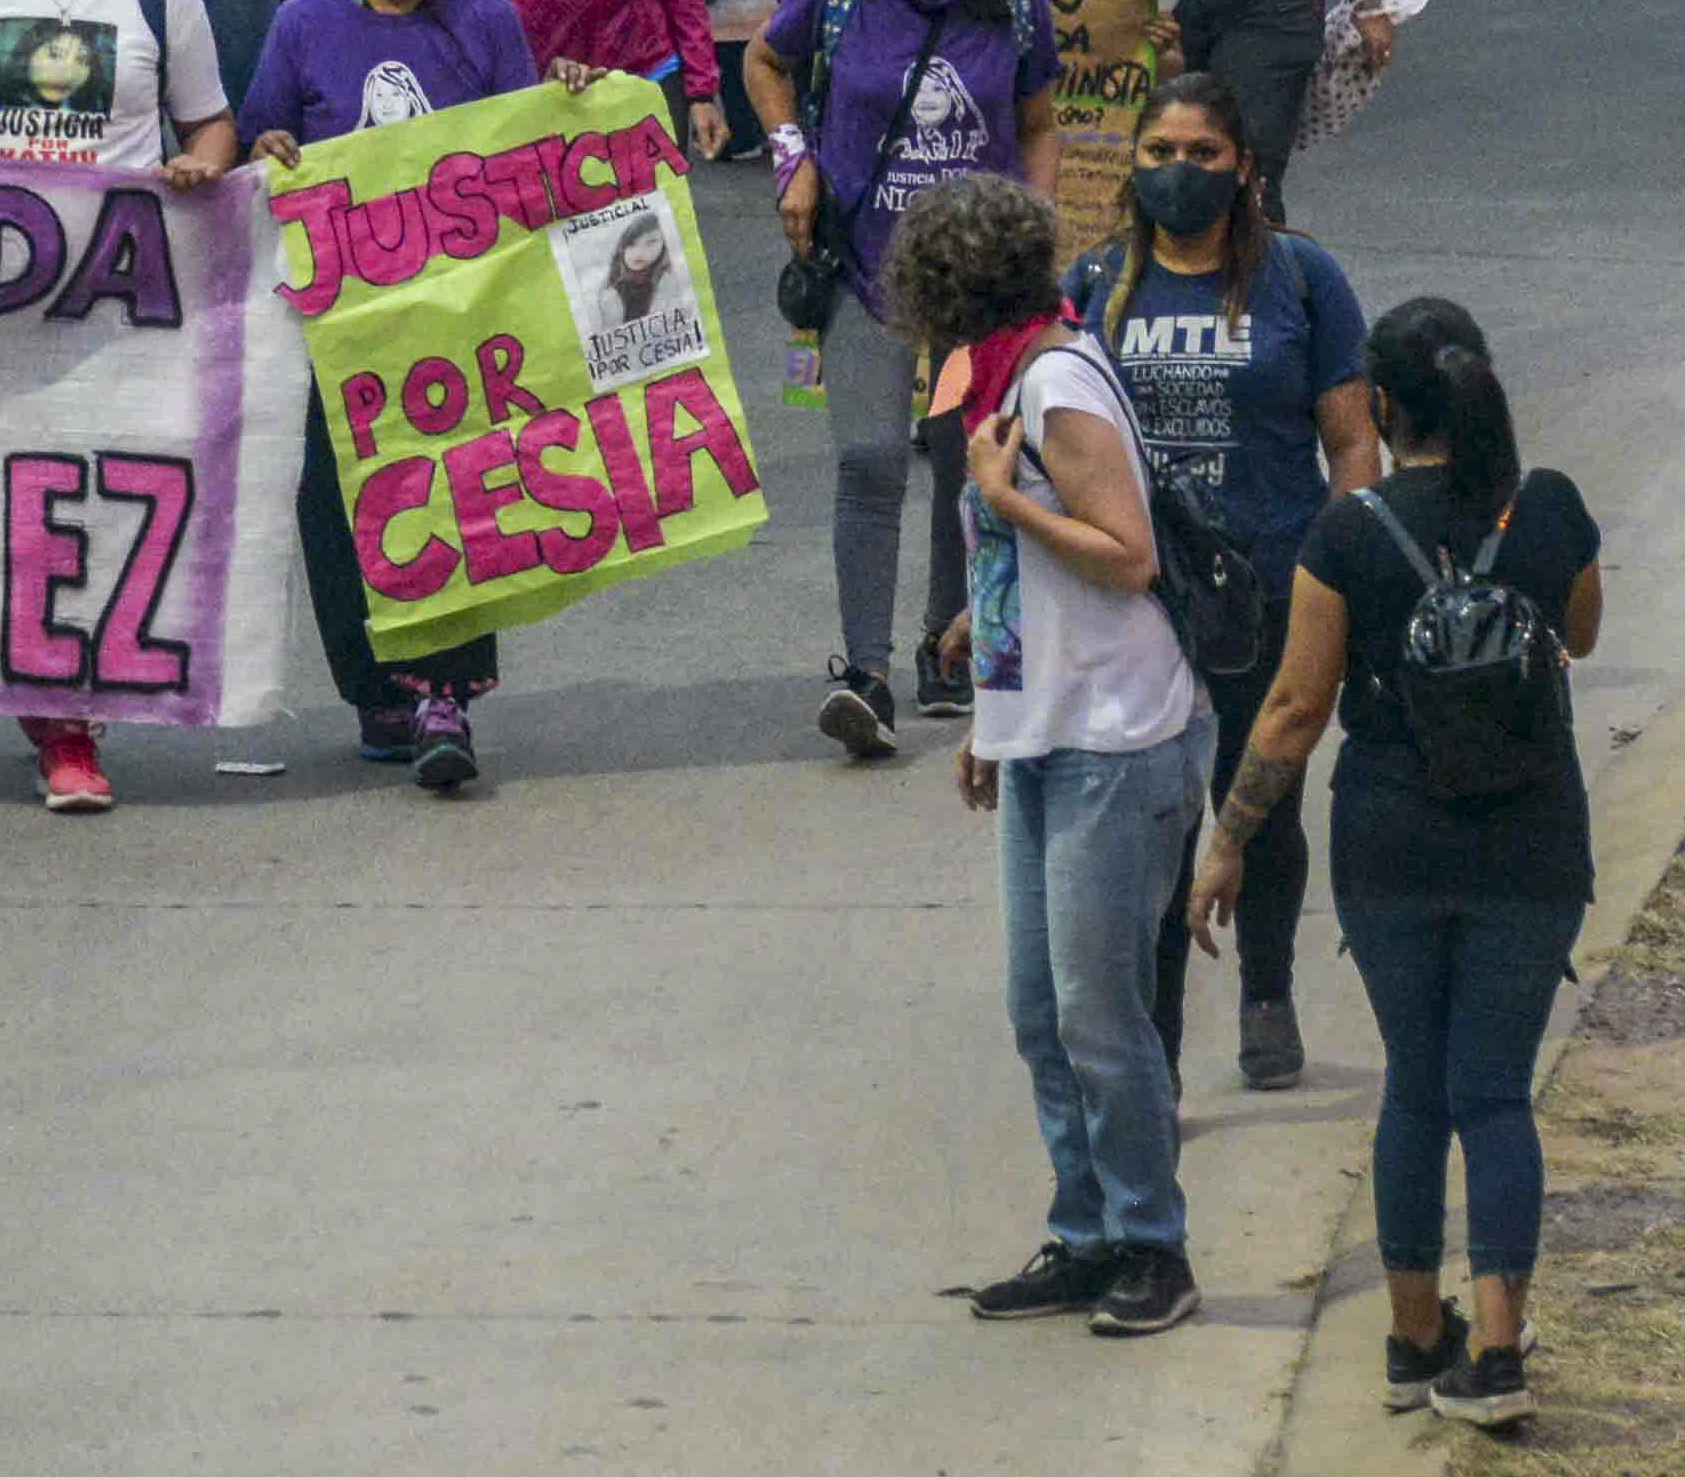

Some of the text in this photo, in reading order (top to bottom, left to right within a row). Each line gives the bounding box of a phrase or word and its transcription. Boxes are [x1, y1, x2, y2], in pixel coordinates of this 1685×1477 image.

[886, 171, 936, 185] JUSTICIA
[269, 114, 692, 317] JUSTICIA
[589, 307, 688, 363] JUSTICIA
[1121, 314, 1253, 357] MTE
[1133, 364, 1213, 382] LUCHANDO
[339, 332, 546, 460] POR
[1157, 381, 1225, 398] SOCIEDAD
[1159, 398, 1231, 416] ESCLAVOS
[1152, 419, 1233, 438] EXCLUIDOS
[353, 366, 761, 603] CESIA
